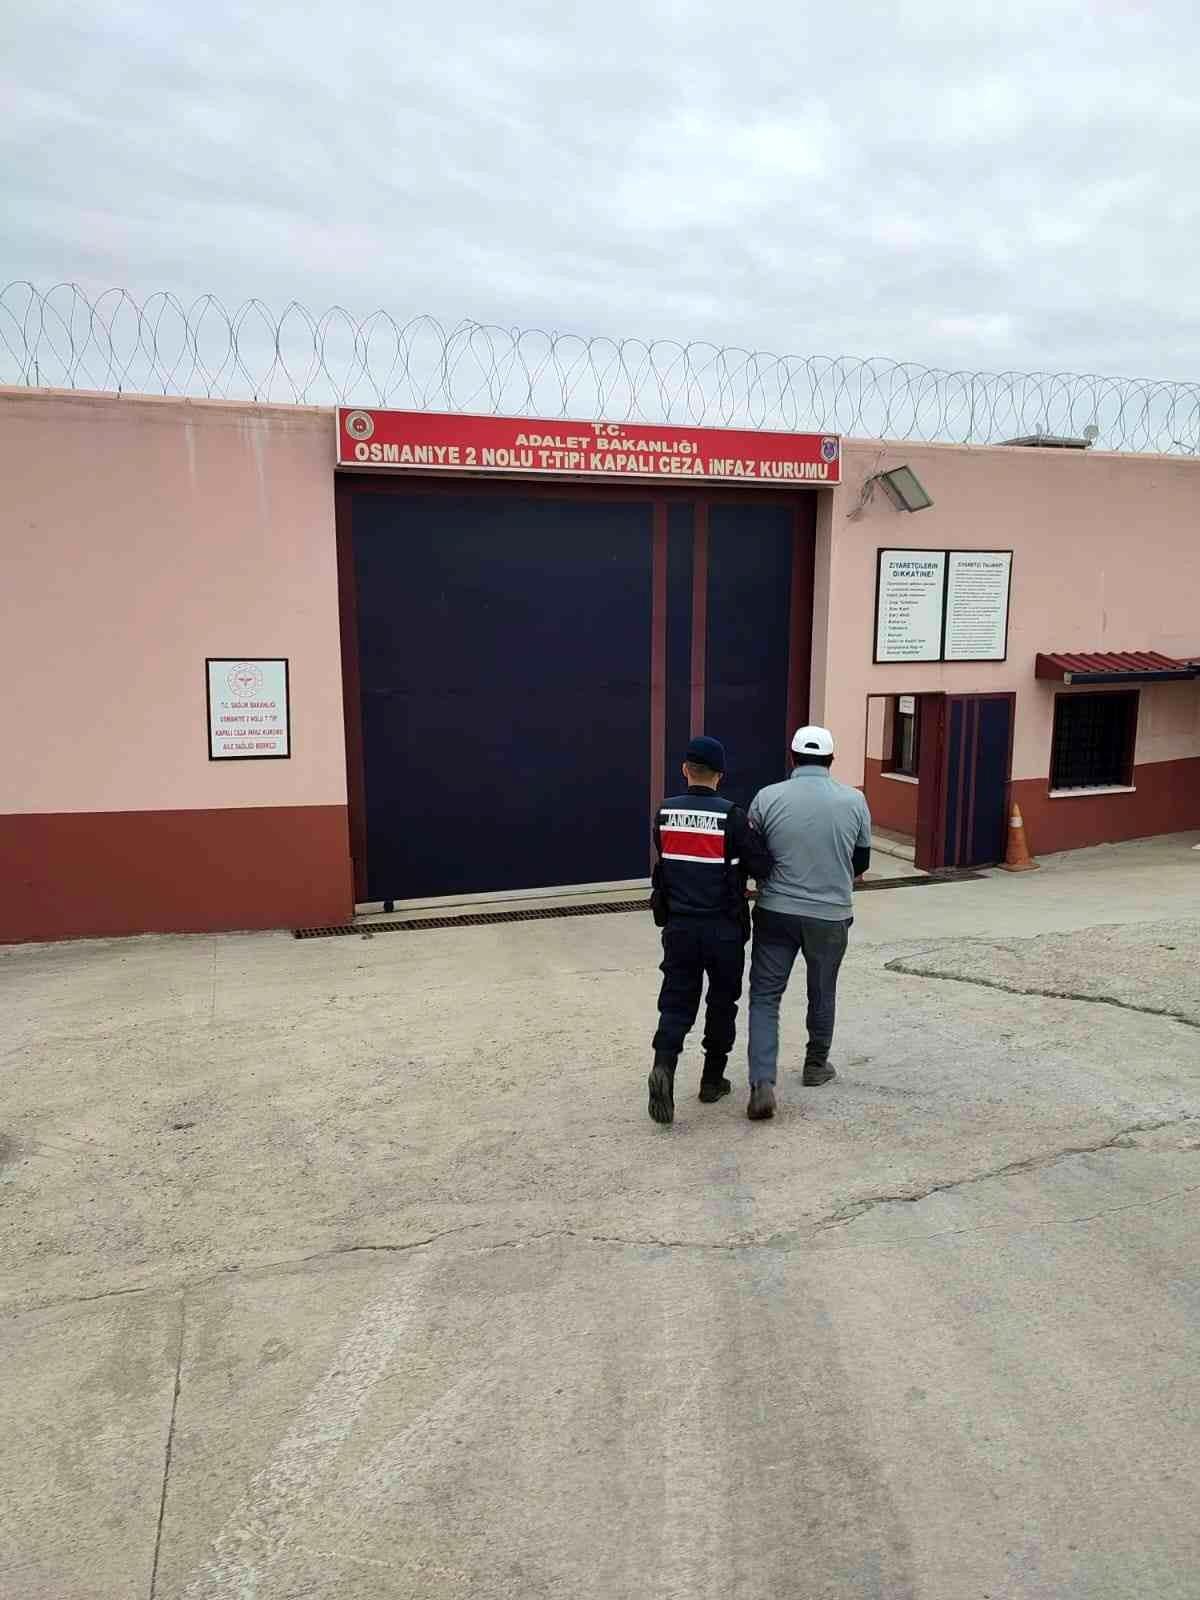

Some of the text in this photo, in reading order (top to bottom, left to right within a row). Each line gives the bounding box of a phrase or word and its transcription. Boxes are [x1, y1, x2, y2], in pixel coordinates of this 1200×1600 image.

[592, 423, 626, 437] T.C.
[515, 433, 698, 454] ADALET BAKANLIĞI
[354, 442, 461, 464] OSMANİYE
[465, 447, 477, 465] 2
[482, 448, 533, 467] NOLU
[589, 453, 655, 472] KAPALI
[658, 458, 705, 475] CEZA
[708, 458, 757, 477] İNFAZ
[760, 461, 829, 479] KURUMU
[665, 813, 719, 832] JANDARMA
